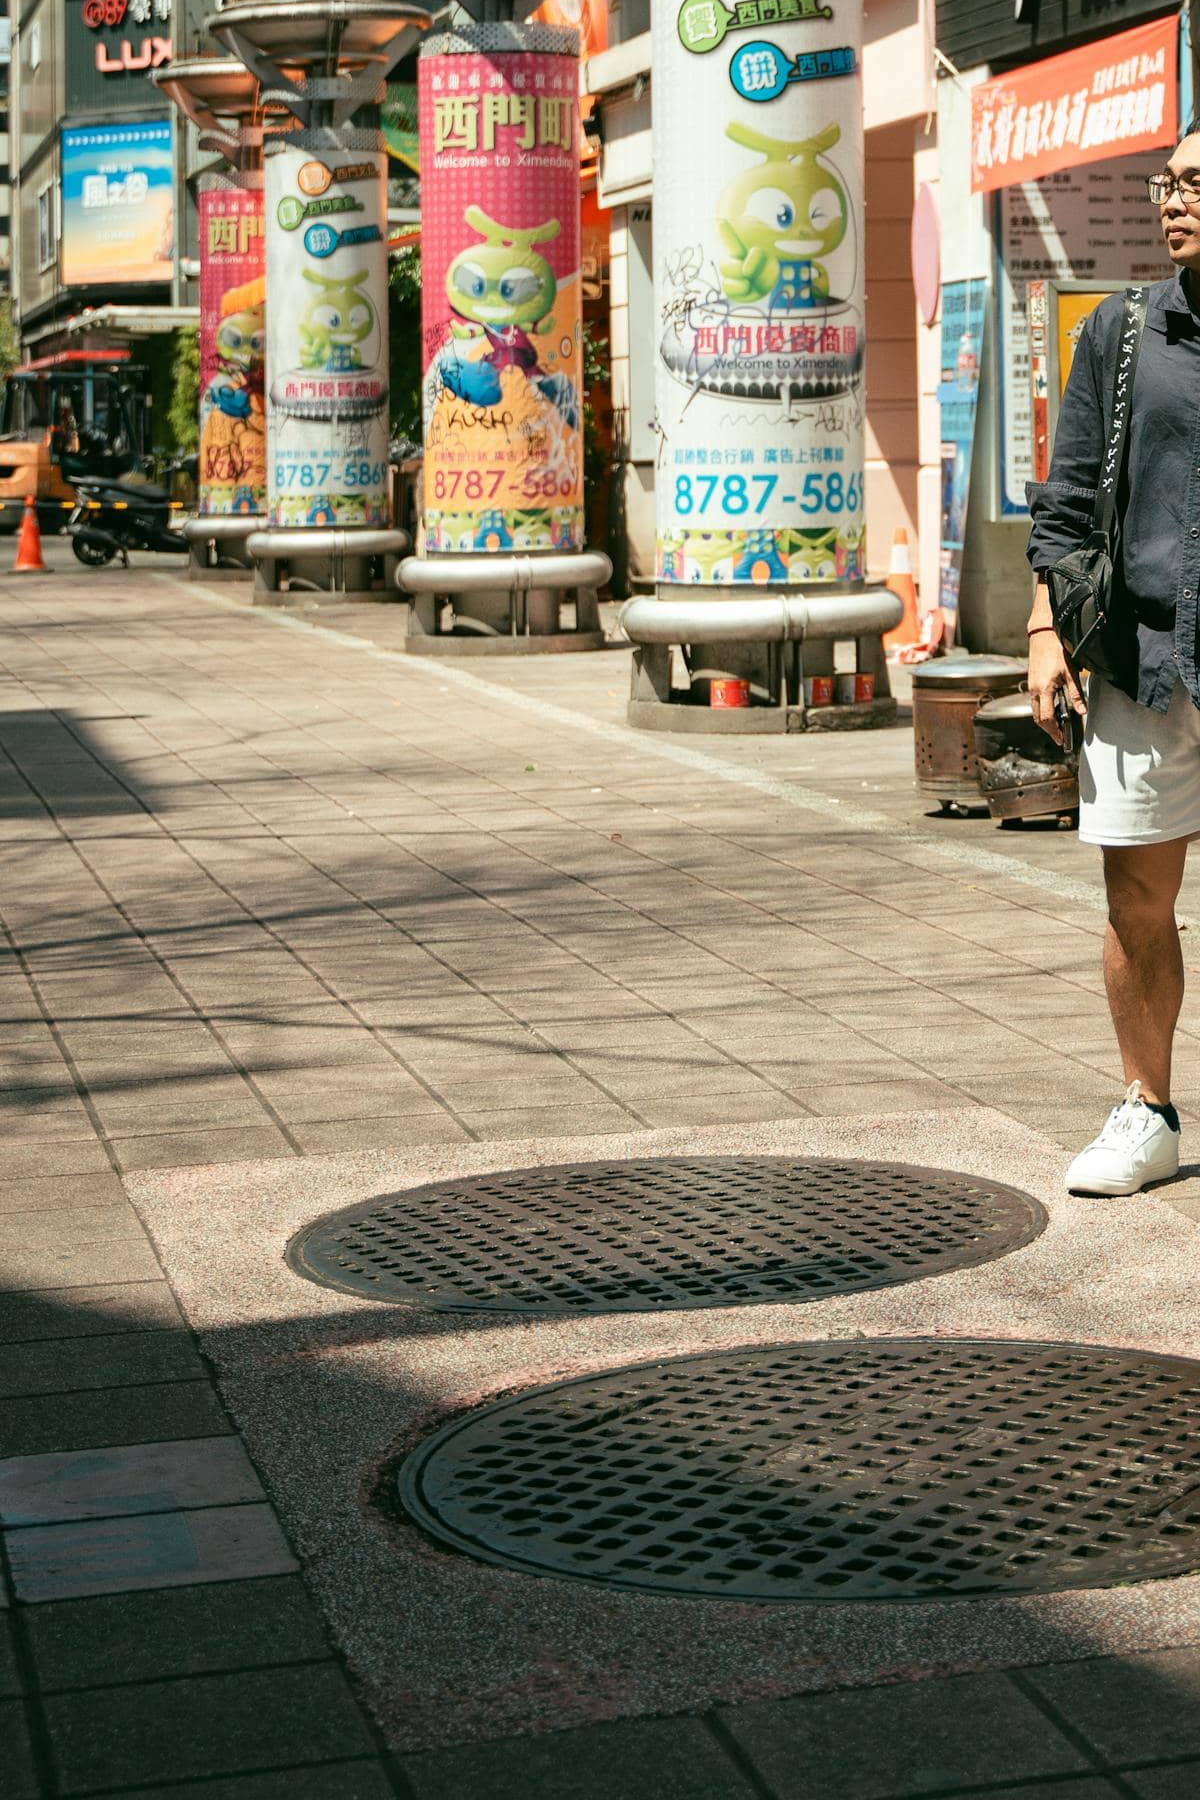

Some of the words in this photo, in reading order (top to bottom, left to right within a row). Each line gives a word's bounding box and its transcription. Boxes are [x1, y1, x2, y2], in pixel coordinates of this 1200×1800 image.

[434, 93, 573, 153] 西門町
[434, 153, 488, 169] Welcome
[495, 154, 510, 166] to
[714, 357, 774, 370] Welcome
[777, 357, 791, 369] to
